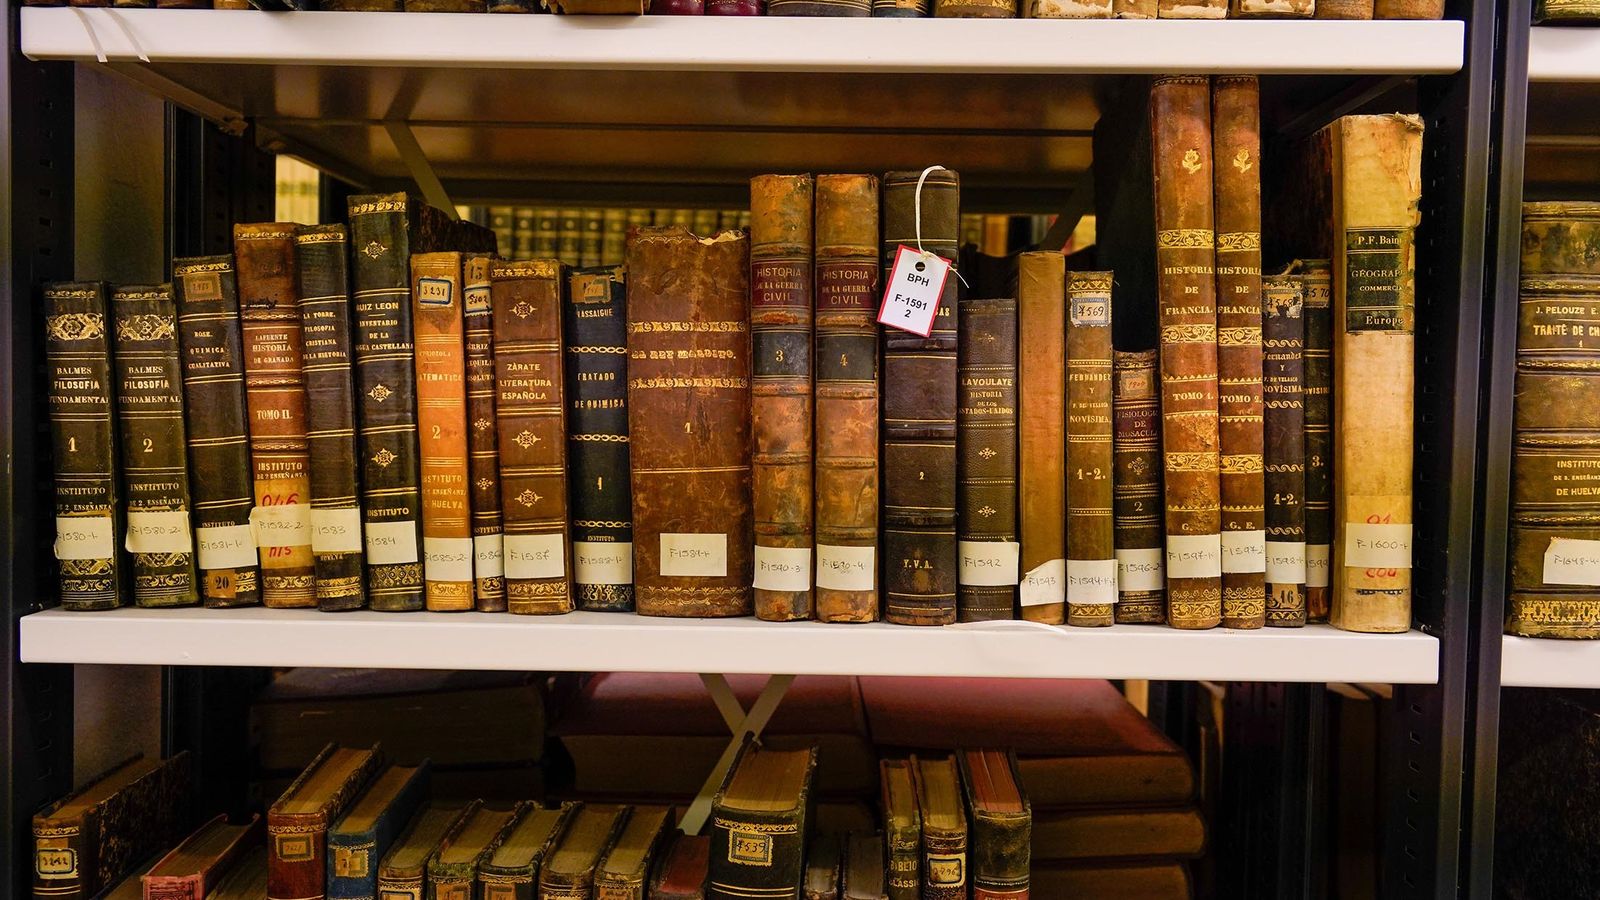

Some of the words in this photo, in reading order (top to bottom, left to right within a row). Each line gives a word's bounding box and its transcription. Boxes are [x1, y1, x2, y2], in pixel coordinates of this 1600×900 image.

[757, 267, 802, 278] HISTORIA
[823, 270, 869, 280] HISTORIA
[1165, 266, 1213, 275] HISTORIA
[907, 273, 930, 287] BPH
[775, 281, 803, 289] GUERRA
[843, 285, 871, 293] GUERRA
[1185, 286, 1199, 294] DE
[1235, 286, 1249, 294] DE
[764, 292, 793, 302] CIVIL
[831, 295, 861, 305] CIVIL
[375, 302, 399, 310] LEON
[894, 294, 928, 311] F-1591
[904, 309, 912, 318] 2
[1535, 306, 1543, 314] J.
[1546, 306, 1585, 314] PELOUZE
[1366, 315, 1403, 326] Europe
[1572, 325, 1584, 336] DE
[305, 339, 337, 347] CRISTIANA
[252, 344, 292, 352] HISTORIA
[775, 350, 784, 362] 3
[840, 353, 848, 367] 4
[57, 367, 92, 375] BALMES
[128, 366, 164, 374] BALMES
[54, 380, 100, 390] FILOSOFIA
[124, 380, 170, 389] FILOSOFIA
[500, 379, 551, 387] LITERATURA
[119, 395, 181, 403] FUNDAMENTAL
[502, 390, 546, 399] ESPAÑOLA
[1173, 392, 1203, 401] TOMO
[1221, 395, 1251, 403] TOMO
[575, 400, 584, 408] DE
[587, 399, 625, 409] QUIMICA
[256, 409, 281, 421] TOMO
[432, 425, 441, 439] 2
[684, 422, 693, 434] 1
[68, 437, 78, 452] 1
[143, 438, 153, 453] 2
[1312, 455, 1324, 467] 3.
[258, 462, 302, 471] INSTITUTO
[130, 482, 180, 492] INSTITUTO
[597, 476, 603, 490] 1
[57, 487, 106, 496] INSTITUTO
[1556, 488, 1569, 496] DE
[431, 500, 463, 509] HUELVA
[1134, 502, 1143, 512] 2
[368, 508, 410, 517] INSTITUTO
[215, 576, 229, 589] 20
[1280, 590, 1294, 603] 16
